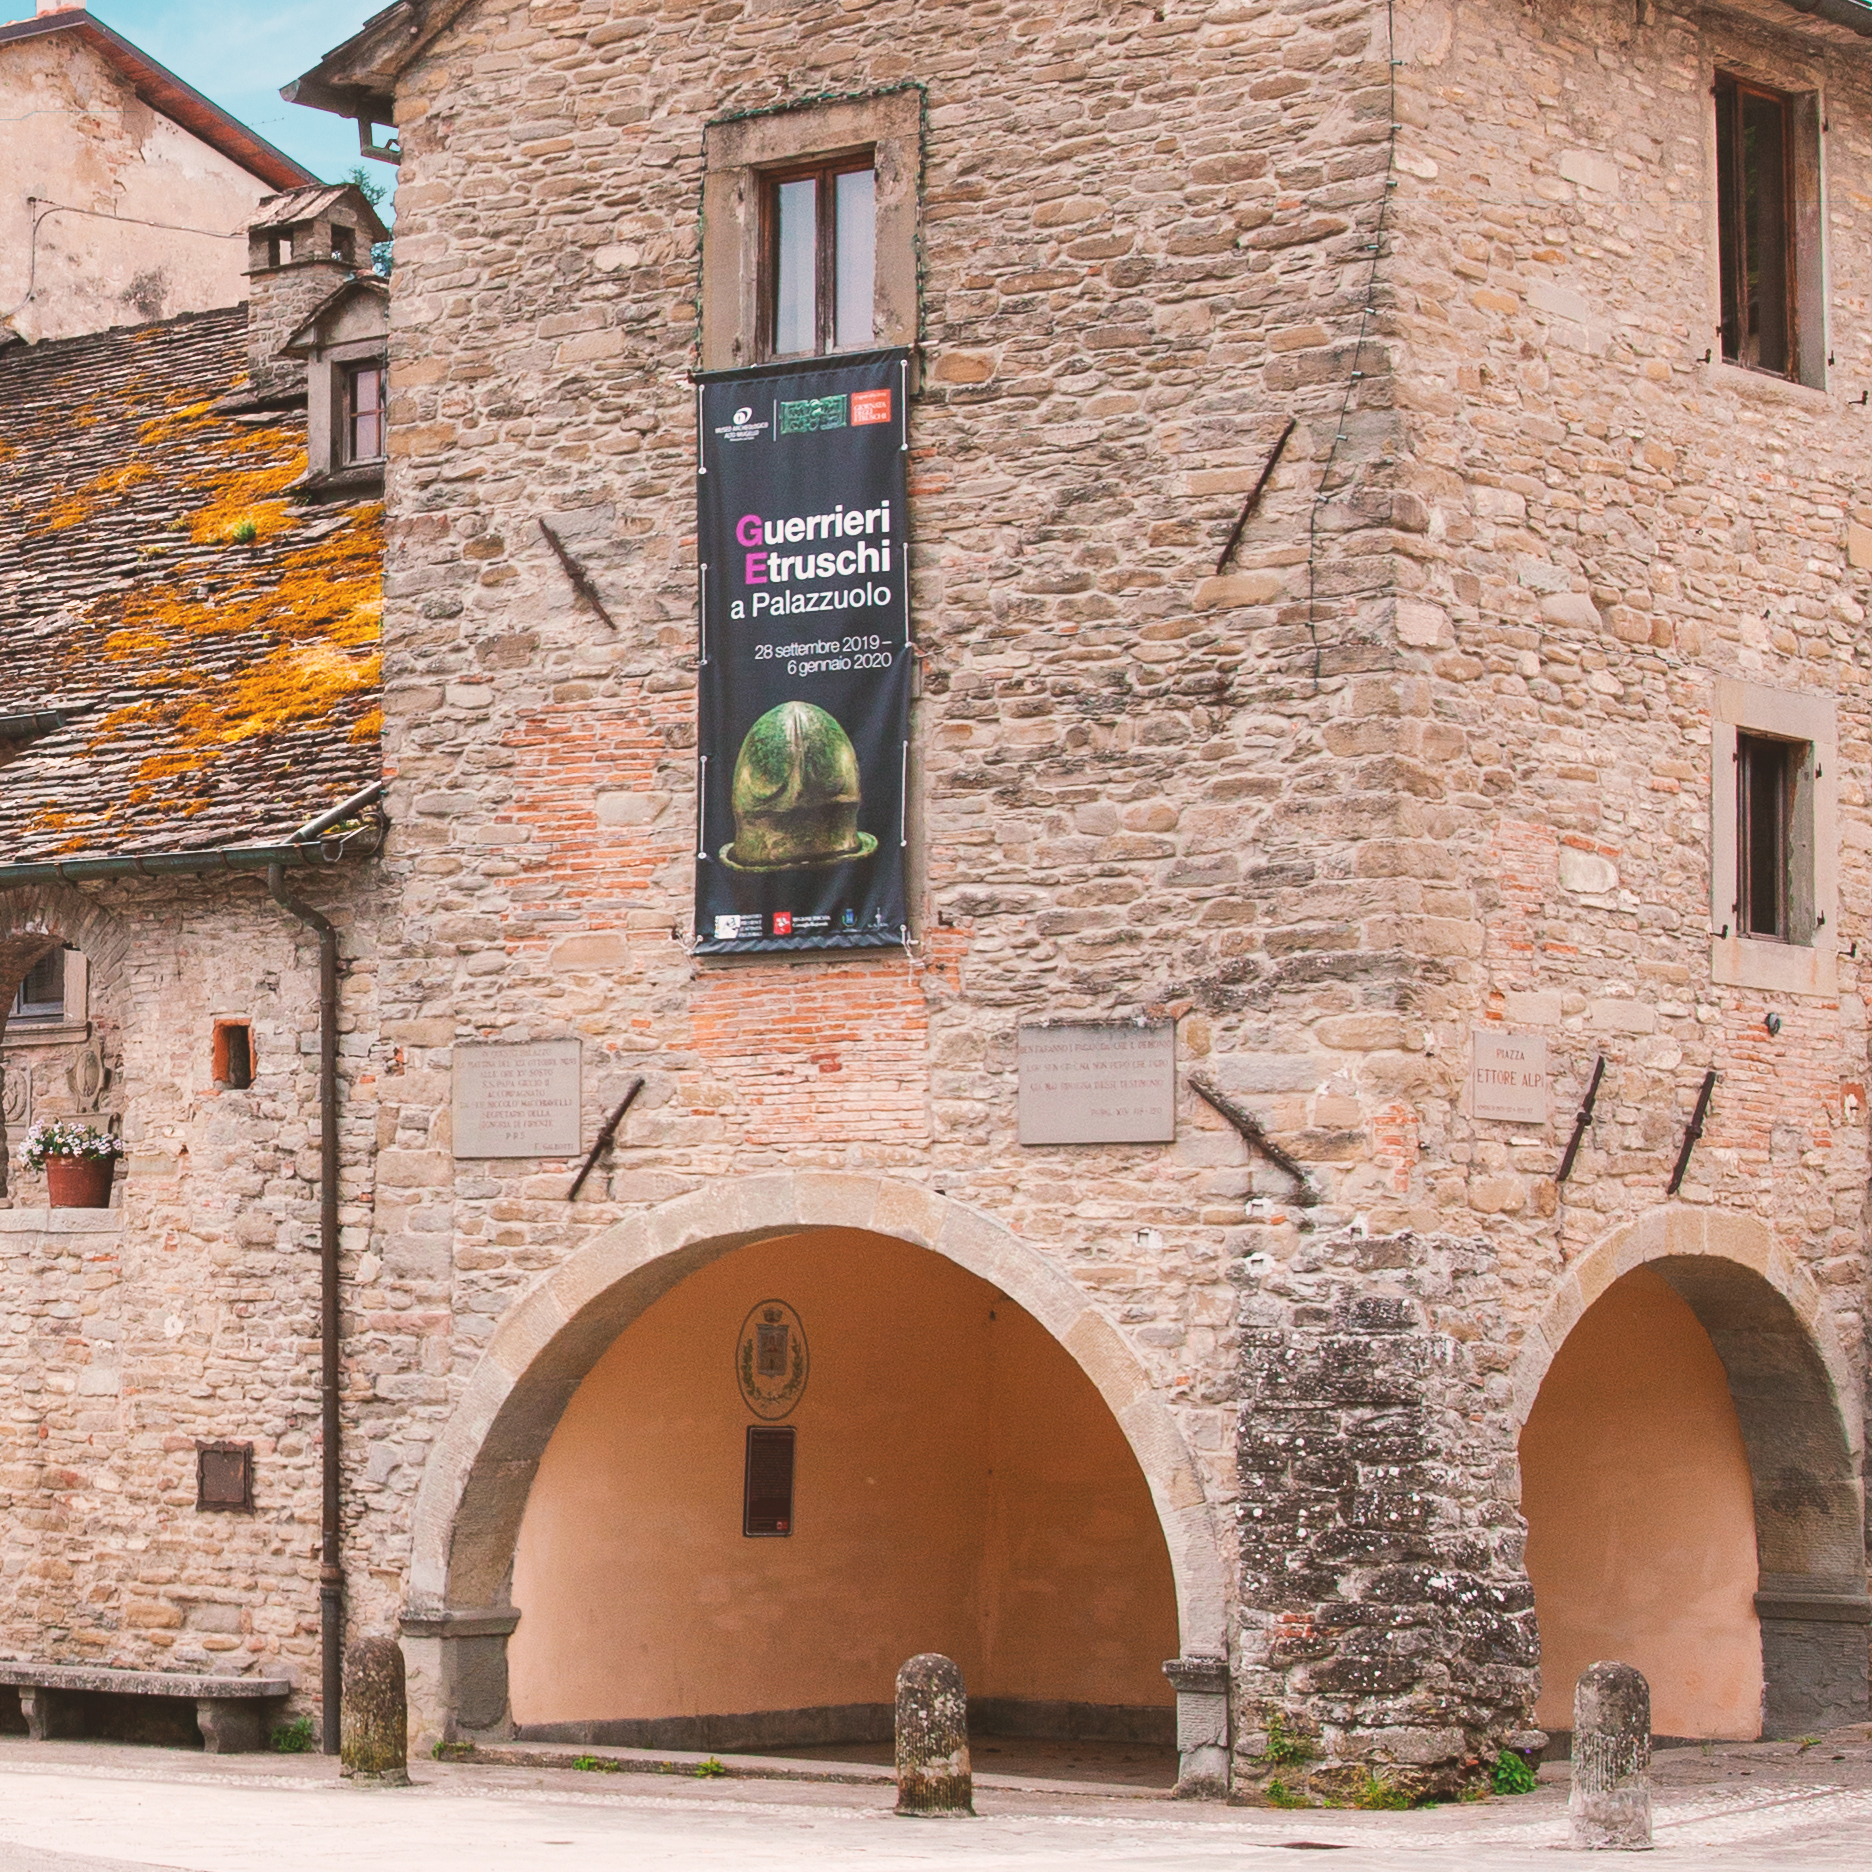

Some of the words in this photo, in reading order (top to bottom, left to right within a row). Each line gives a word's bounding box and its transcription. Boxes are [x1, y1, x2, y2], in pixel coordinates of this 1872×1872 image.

[735, 499, 890, 547] Guerrieri
[745, 539, 891, 585] Etruschi
[730, 599, 745, 619] a
[752, 581, 892, 618] Palazzuolo
[755, 644, 773, 660] 28
[775, 639, 841, 658] settembre
[842, 634, 880, 652] 2019
[787, 659, 797, 675] 6
[799, 655, 851, 677] gennaio
[853, 651, 892, 669] 2020
[1496, 1048, 1525, 1061] PIAZZA
[1477, 1068, 1517, 1086] ETTORE
[1522, 1073, 1544, 1088] ALPI
